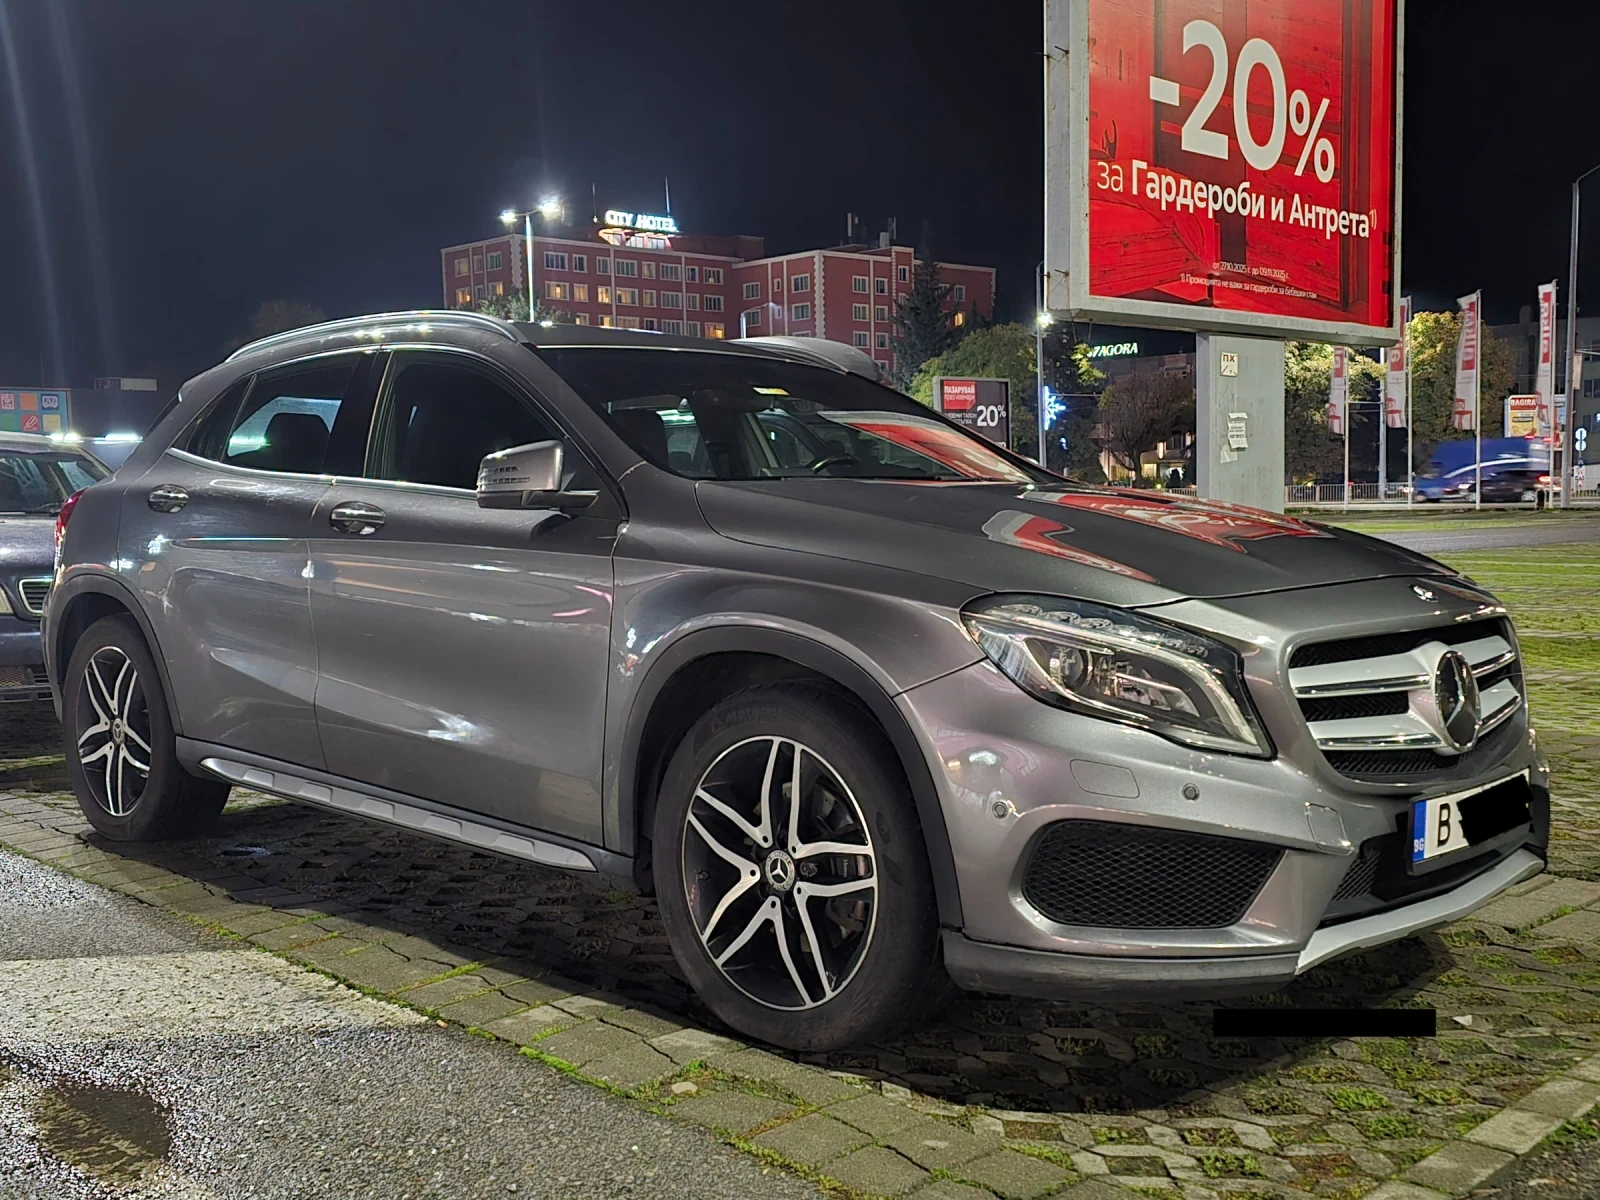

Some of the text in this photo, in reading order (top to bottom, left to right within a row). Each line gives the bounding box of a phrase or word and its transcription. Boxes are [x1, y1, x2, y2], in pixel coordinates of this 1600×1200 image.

[1149, 20, 1335, 183] -20%
[1131, 159, 1265, 219] Гардероби
[1271, 196, 1284, 222] и
[605, 209, 677, 232] CITY HOTEL
[1251, 267, 1259, 276] до
[1186, 273, 1221, 286] Промоцията
[1221, 280, 1229, 288] не
[1223, 354, 1235, 363] ПХ
[944, 384, 975, 394] ПАЗАРУВАЙ
[1510, 398, 1537, 406] BAGIRA
[977, 404, 1007, 427] 20%
[1413, 838, 1425, 853] BG
